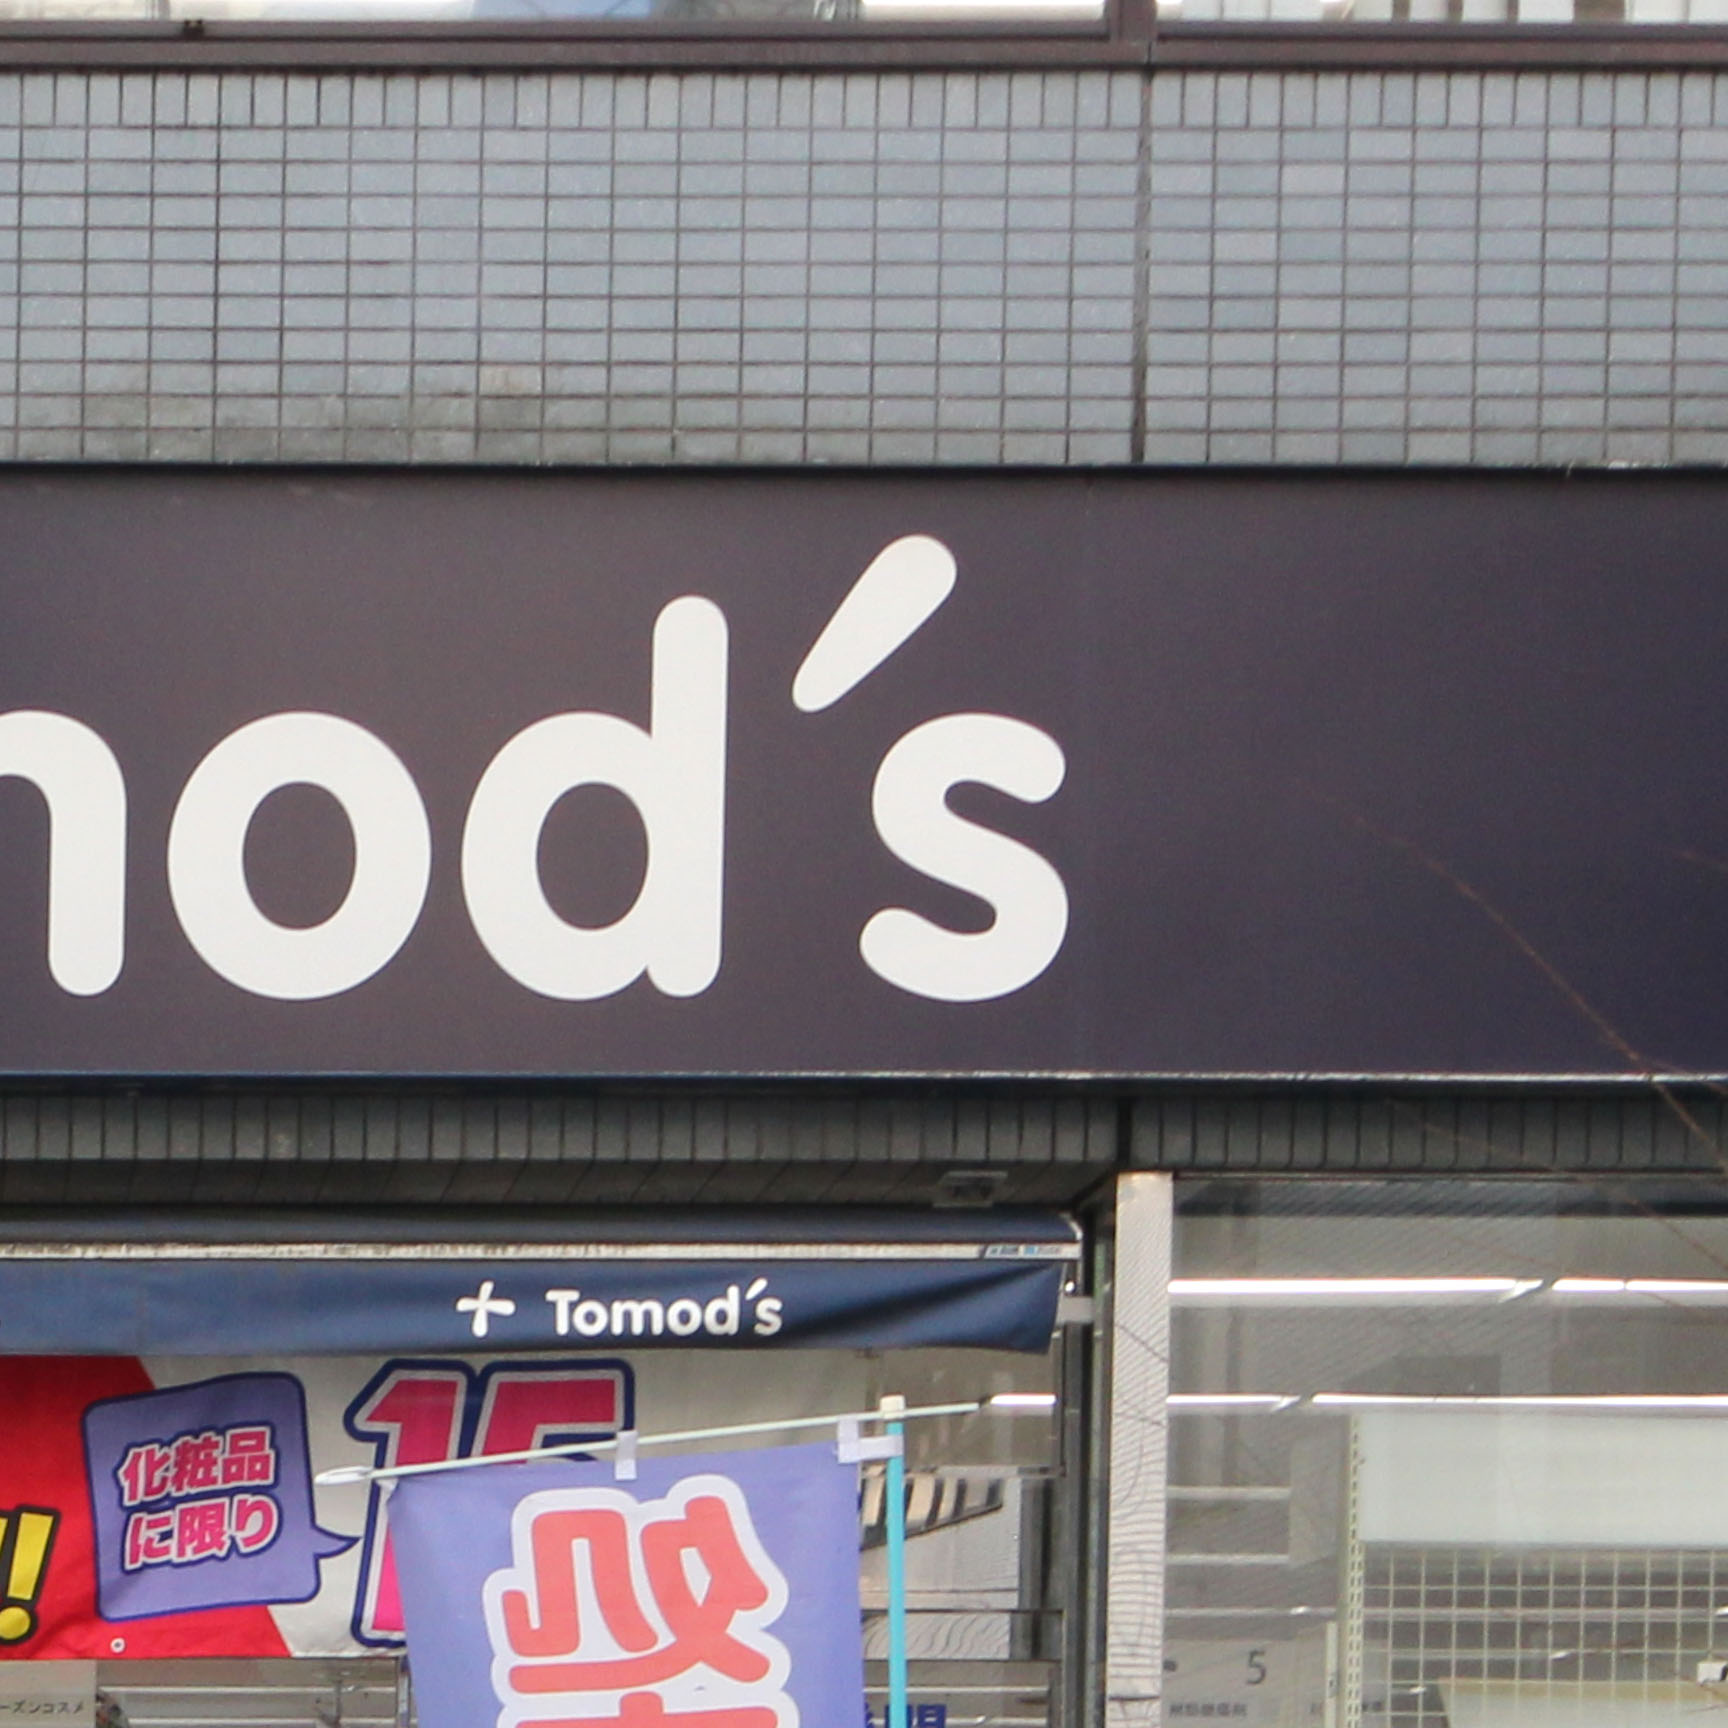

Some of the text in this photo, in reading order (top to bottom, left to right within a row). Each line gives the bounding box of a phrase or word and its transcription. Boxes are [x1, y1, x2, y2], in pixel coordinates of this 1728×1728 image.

[545, 1279, 784, 1338] Tomod's
[120, 1424, 277, 1504] 化粧品
[120, 1494, 280, 1572] に限り
